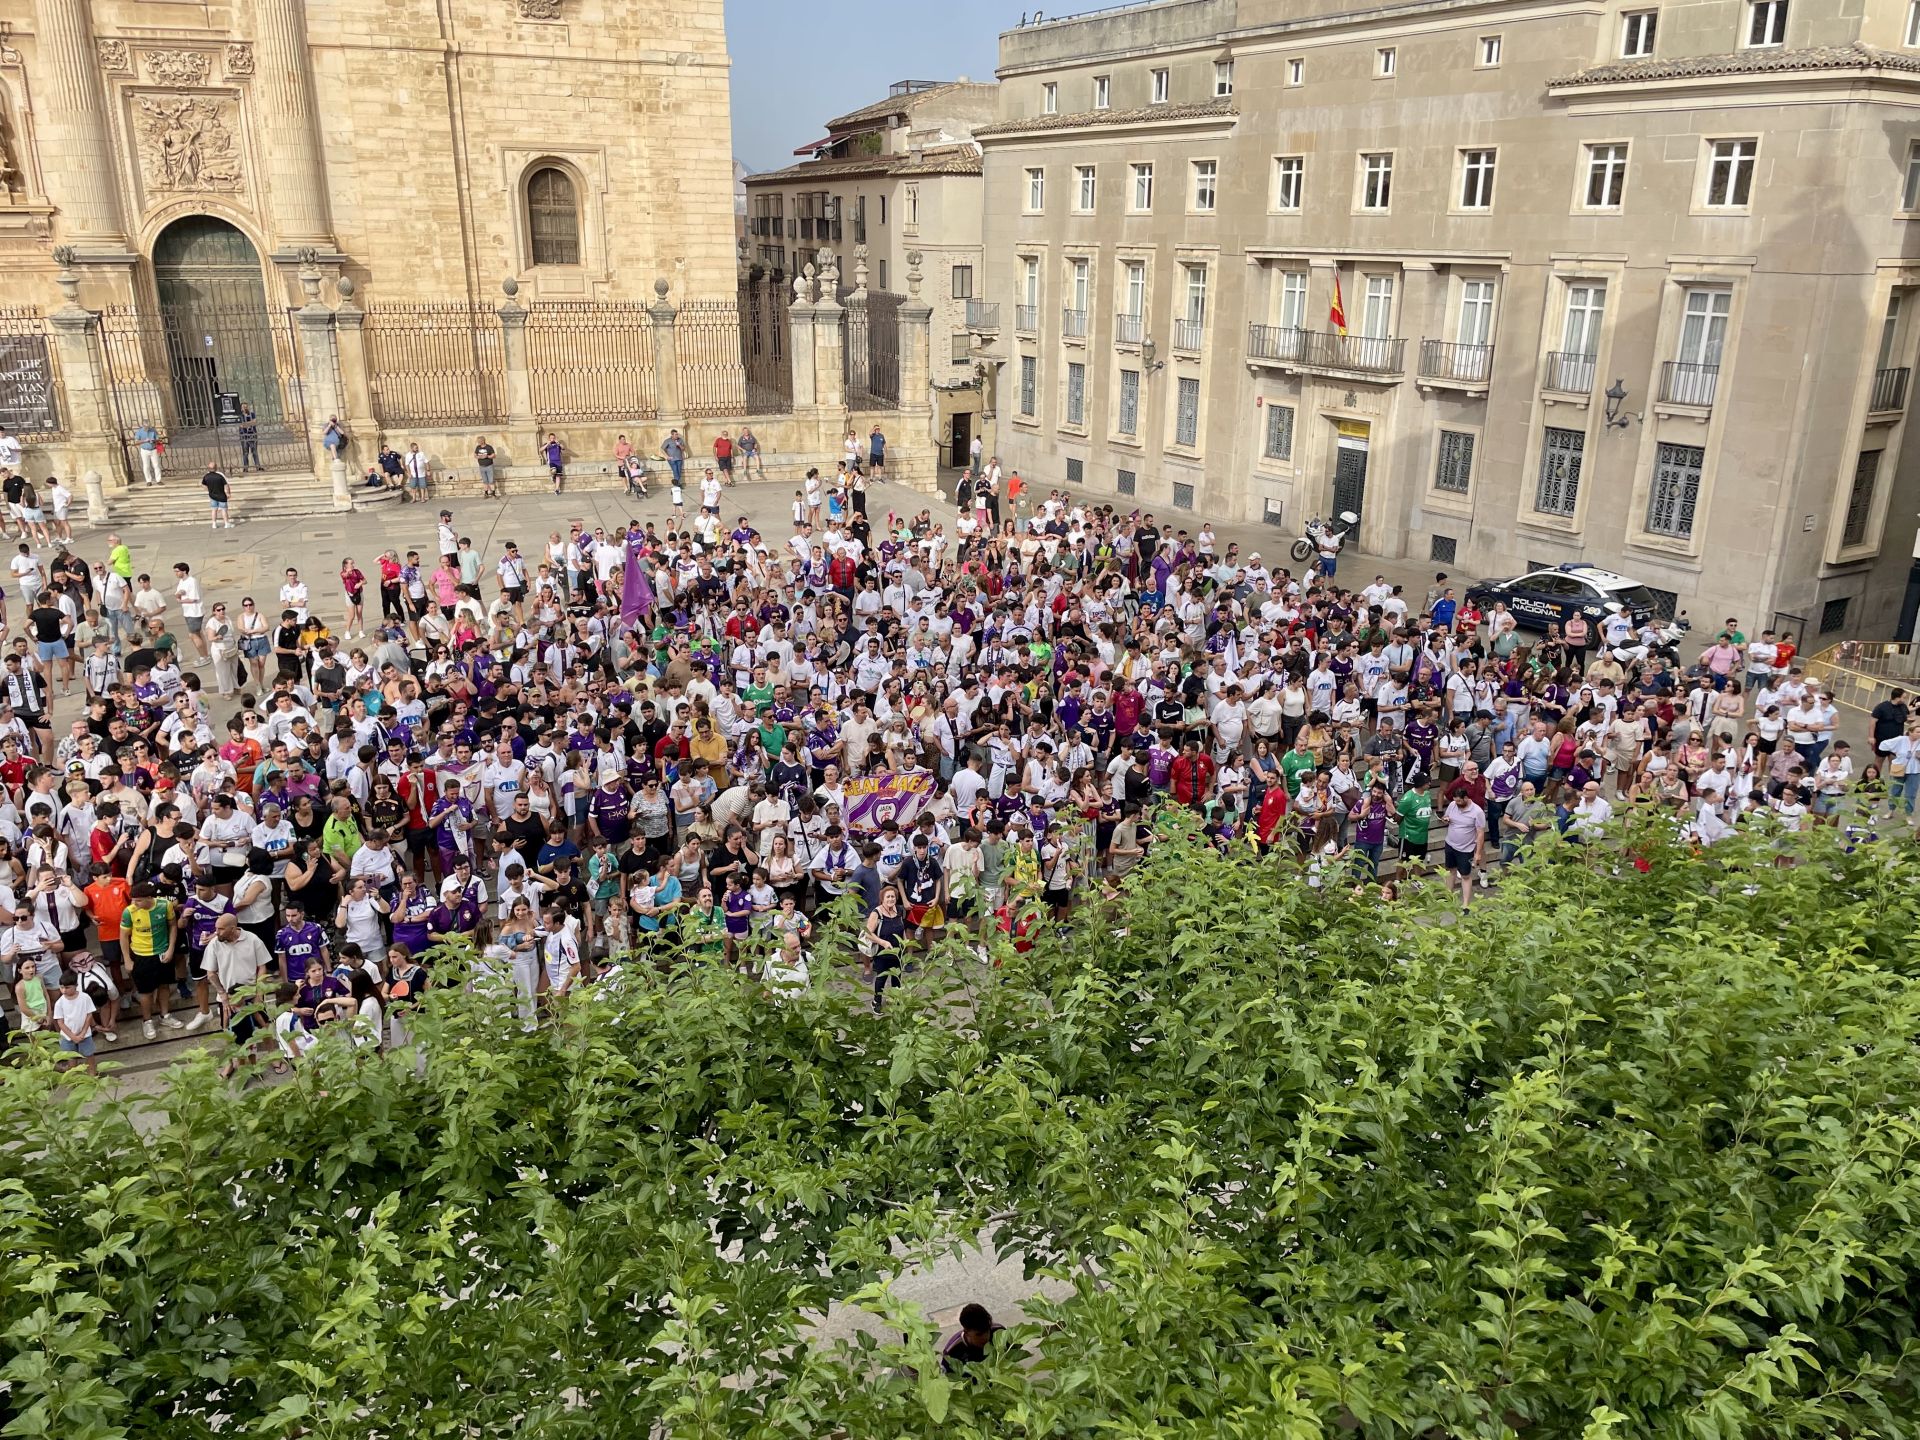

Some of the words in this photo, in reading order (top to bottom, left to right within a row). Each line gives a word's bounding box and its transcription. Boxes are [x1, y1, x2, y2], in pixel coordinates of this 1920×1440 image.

[17, 359, 42, 369] THE
[17, 382, 45, 392] MAN
[1512, 597, 1552, 610] POLICIA
[1512, 604, 1562, 618] NACIONAL
[1583, 605, 1602, 616] 200
